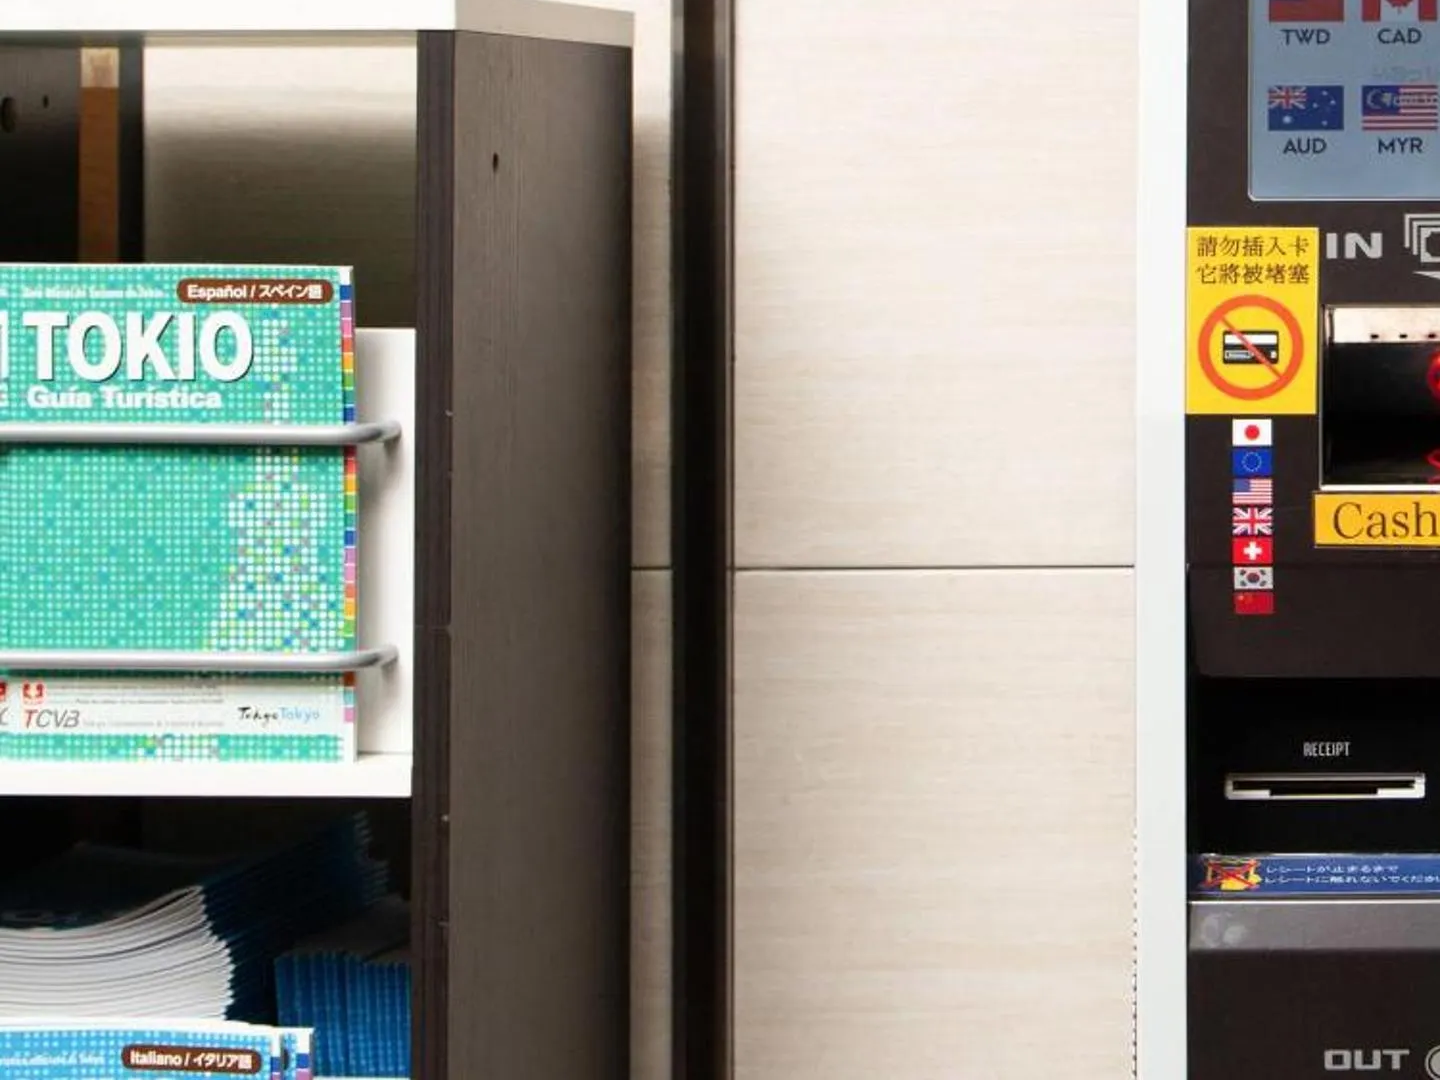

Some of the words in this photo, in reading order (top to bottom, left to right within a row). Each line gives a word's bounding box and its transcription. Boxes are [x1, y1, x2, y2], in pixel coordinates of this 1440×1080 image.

[1281, 29, 1331, 46] TWD
[1377, 28, 1422, 45] CAD
[1283, 138, 1327, 155] AUD
[1378, 137, 1423, 154] MYR
[1196, 235, 1310, 257] 請勿插入卡
[1326, 232, 1383, 260] IN
[1196, 263, 1310, 285] 它將被堵塞
[187, 284, 247, 302] Español
[22, 310, 254, 383] TOKIO
[26, 385, 93, 409] Guía
[101, 384, 223, 409] Turística
[1333, 501, 1440, 540] Cash
[24, 709, 81, 729] TCVB
[1303, 741, 1351, 758] RECEIPT
[130, 1051, 183, 1067] Italiano
[1323, 1048, 1411, 1071] OUT
